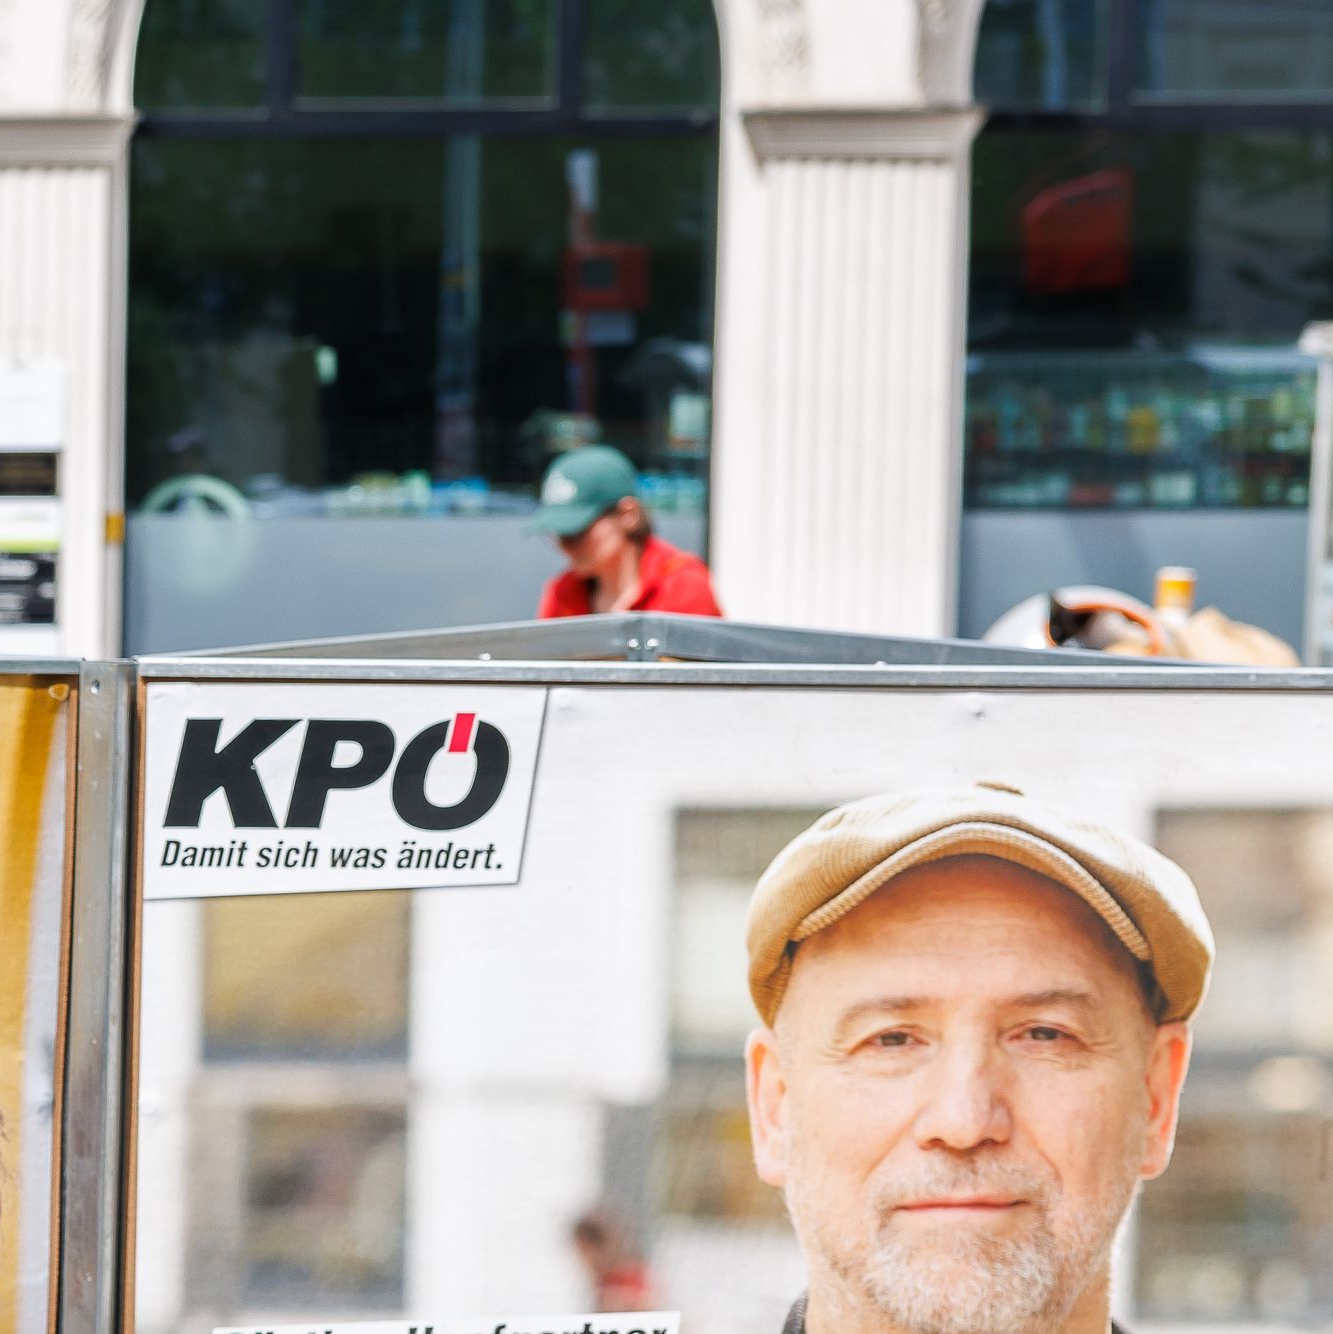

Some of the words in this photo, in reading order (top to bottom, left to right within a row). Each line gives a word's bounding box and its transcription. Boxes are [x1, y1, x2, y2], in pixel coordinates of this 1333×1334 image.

[164, 713, 509, 830] KPÖ
[160, 839, 248, 868] Damit
[255, 840, 320, 869] sich
[330, 847, 388, 869] was
[396, 840, 504, 870] ändert.
